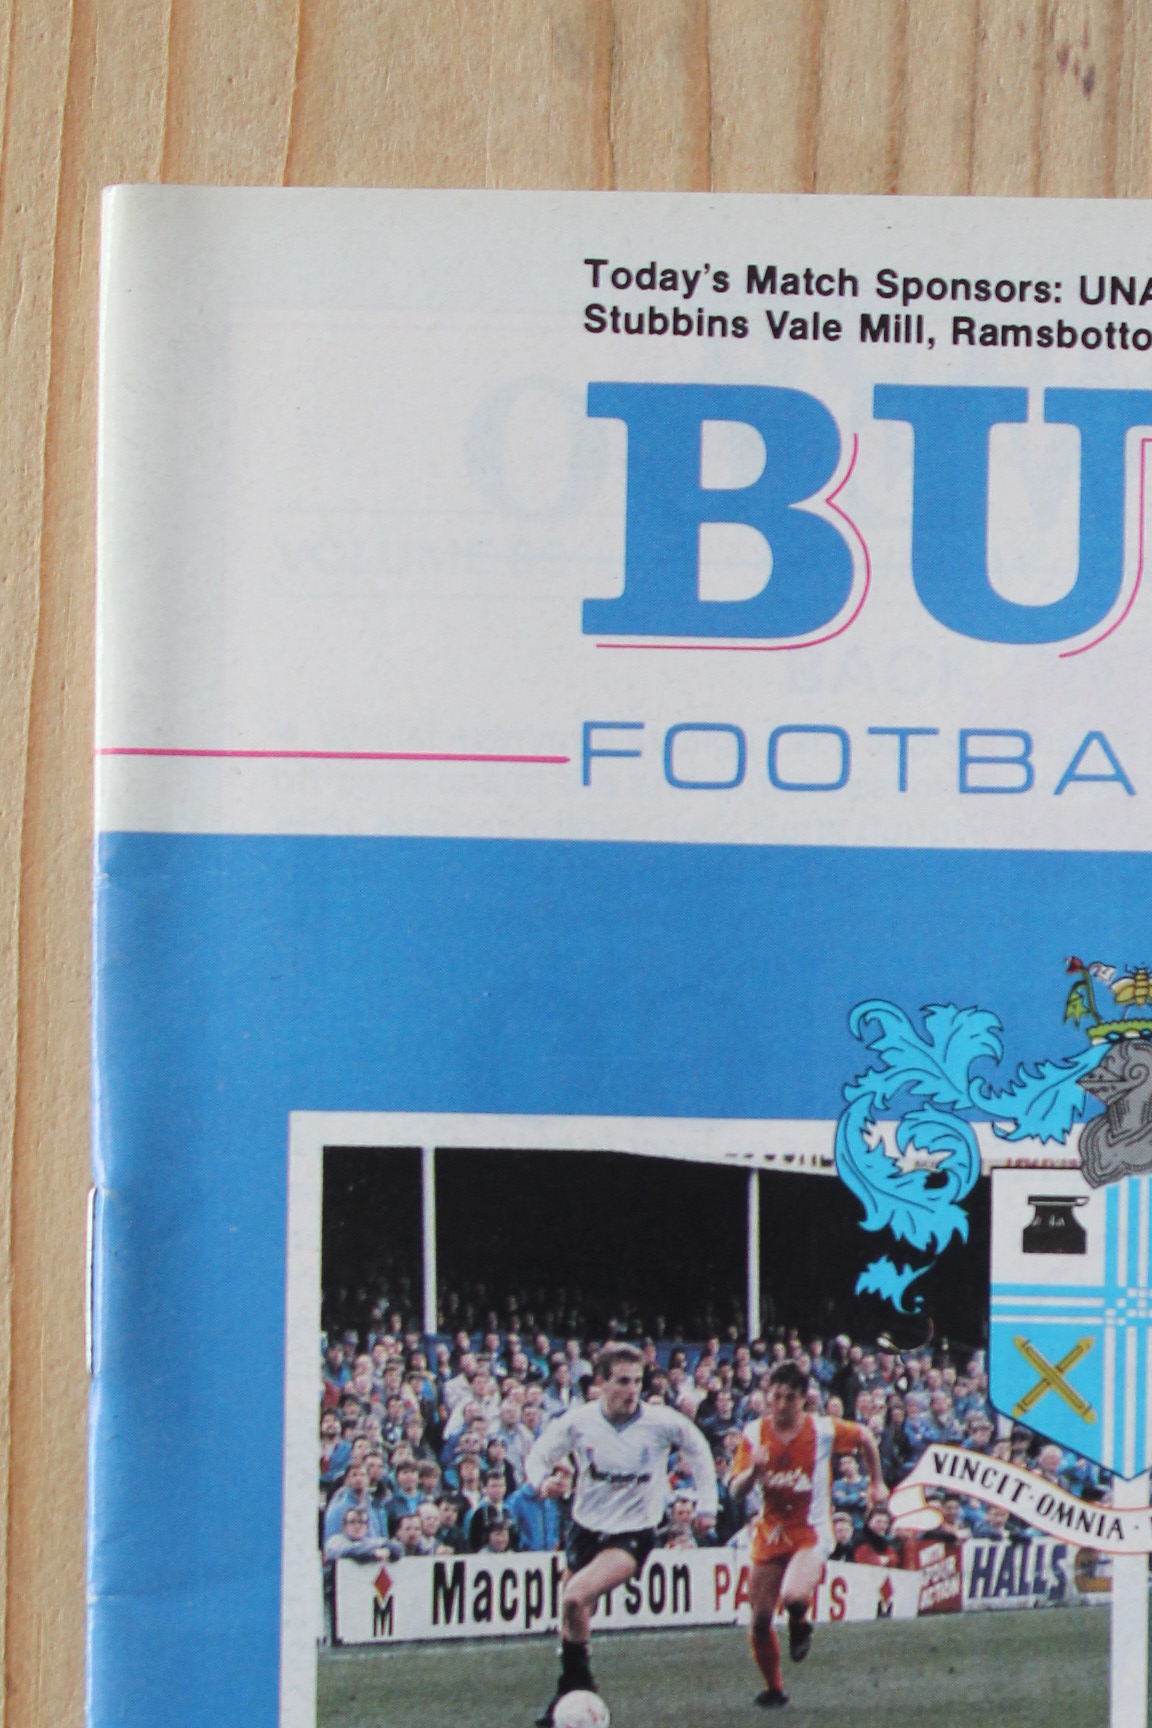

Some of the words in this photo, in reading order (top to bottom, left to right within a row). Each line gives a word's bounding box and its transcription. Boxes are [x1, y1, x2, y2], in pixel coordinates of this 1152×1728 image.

[583, 258, 730, 300] Today's
[746, 264, 859, 298] Match
[875, 268, 1062, 307] Sponsors:
[583, 303, 749, 339] Stubbins
[765, 309, 843, 342] Vale
[860, 313, 935, 350] Mill,
[931, 1452, 1033, 1503] VINCIT
[1035, 1494, 1126, 1541] OMNIA
[431, 1556, 692, 1630] Macphson
[714, 1563, 849, 1621] PATS
[968, 1542, 1069, 1601] HALLS
